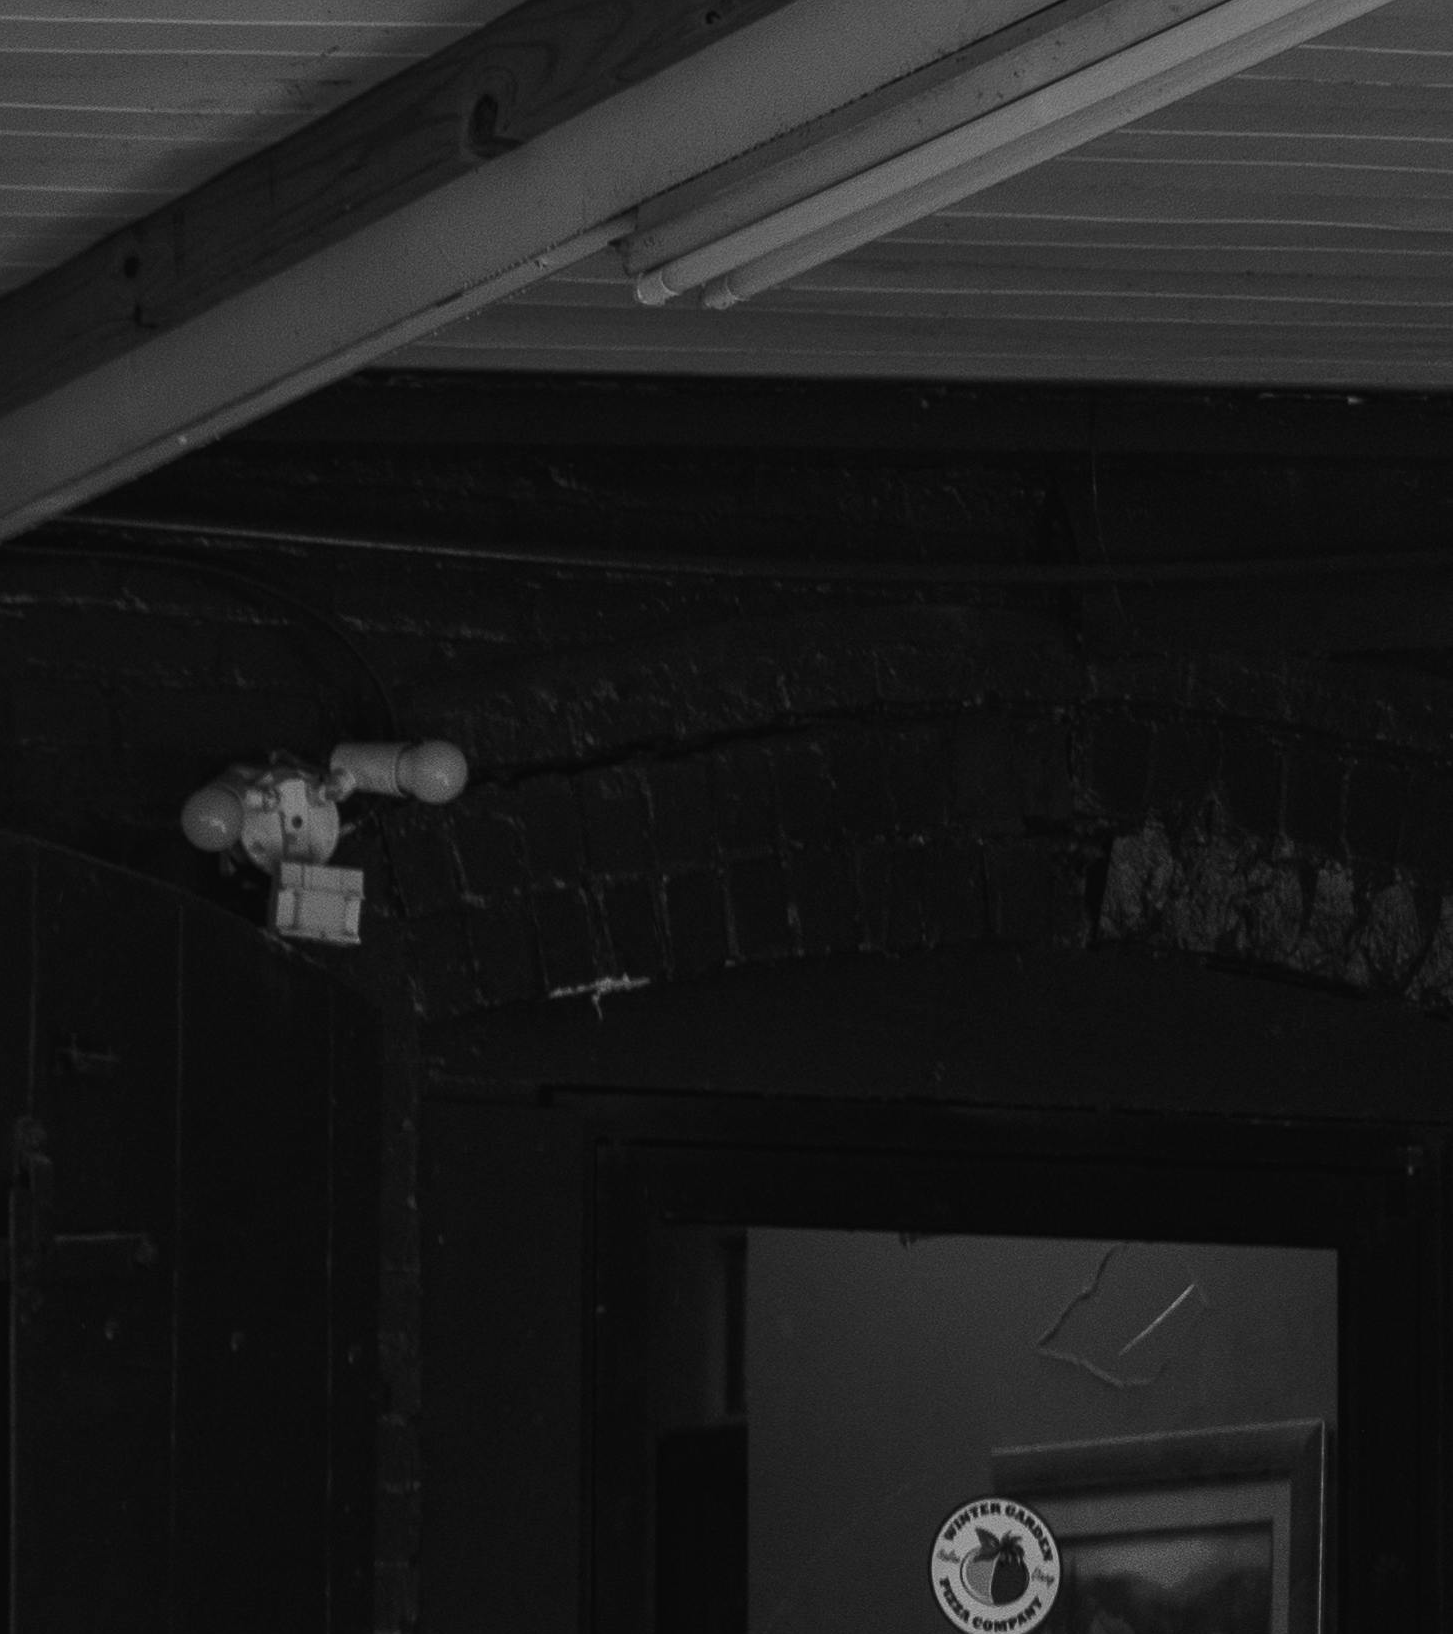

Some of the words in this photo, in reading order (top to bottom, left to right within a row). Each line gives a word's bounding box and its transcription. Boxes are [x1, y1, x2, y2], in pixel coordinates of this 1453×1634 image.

[944, 1502, 1001, 1541] WINTER
[1005, 1503, 1053, 1561] GARDEN
[939, 1577, 970, 1623] PIZZA
[972, 1595, 1042, 1632] COMPANY
